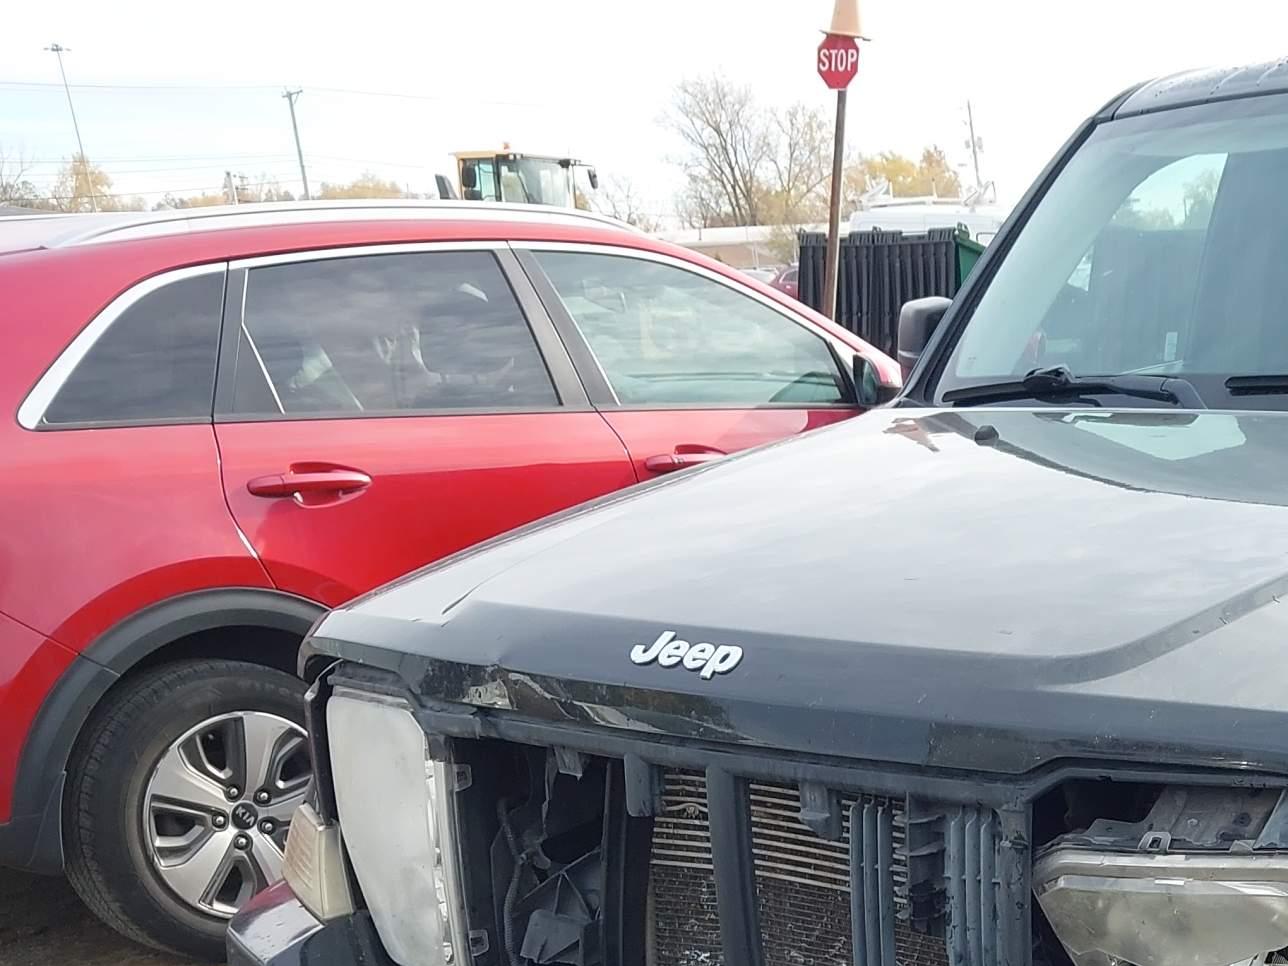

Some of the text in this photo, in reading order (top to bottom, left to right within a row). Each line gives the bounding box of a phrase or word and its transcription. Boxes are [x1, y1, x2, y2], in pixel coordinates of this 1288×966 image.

[819, 49, 857, 72] STOP
[630, 630, 743, 680] Jeep
[235, 805, 256, 826] KIA
